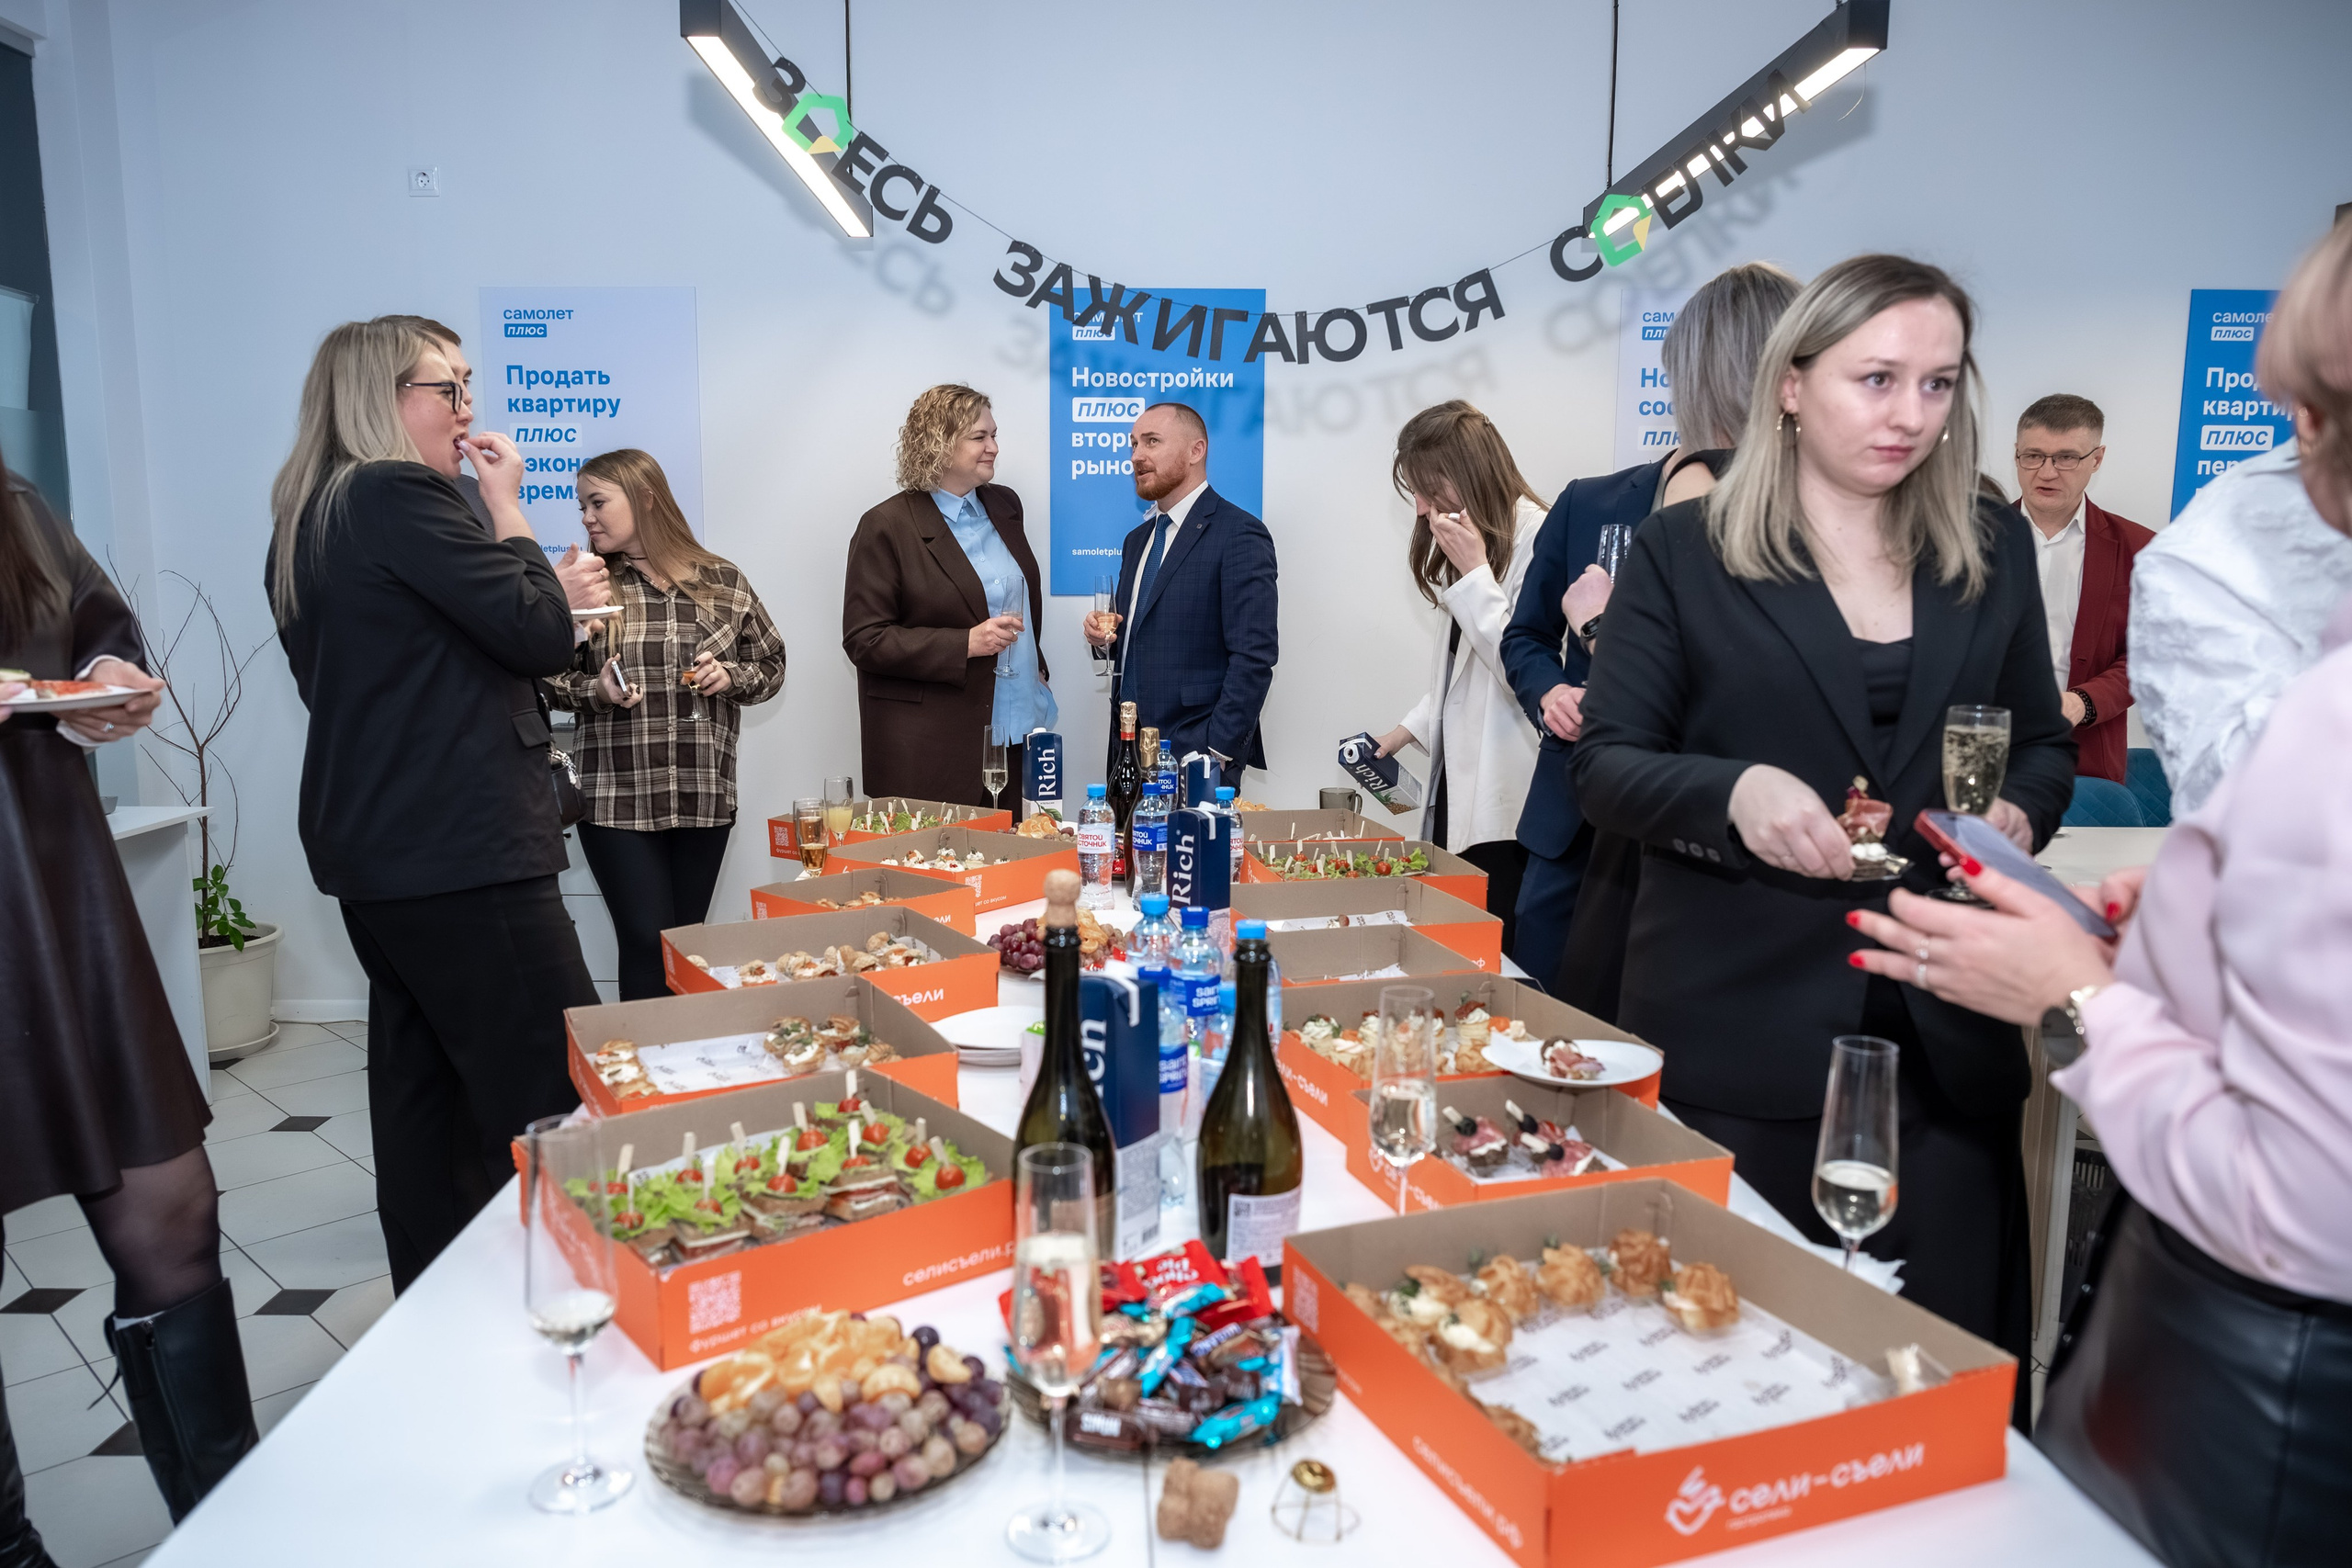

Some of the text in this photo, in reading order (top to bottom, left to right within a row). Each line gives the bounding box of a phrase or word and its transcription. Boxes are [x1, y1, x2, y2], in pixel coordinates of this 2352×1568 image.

[993, 241, 1505, 365] ЗАЖИГАЮТСЯ
[503, 309, 574, 320] самолет
[1643, 311, 1675, 322] сам
[2212, 312, 2274, 323] самоле
[506, 325, 545, 336] плюс
[2214, 329, 2252, 339] плюс
[506, 365, 611, 389] Продать
[1072, 367, 1234, 393] Новостройки
[507, 397, 621, 418] квартиру
[1078, 402, 1140, 417] плюс
[515, 428, 577, 443] плюс
[2206, 431, 2269, 446] плюс
[1072, 460, 1135, 480] рыно
[1072, 547, 1122, 558] samoletplu
[1037, 748, 1057, 797] Rich
[1355, 763, 1390, 791] Rich
[1171, 834, 1195, 906] Rich
[1729, 1443, 1925, 1516] сели-съели
